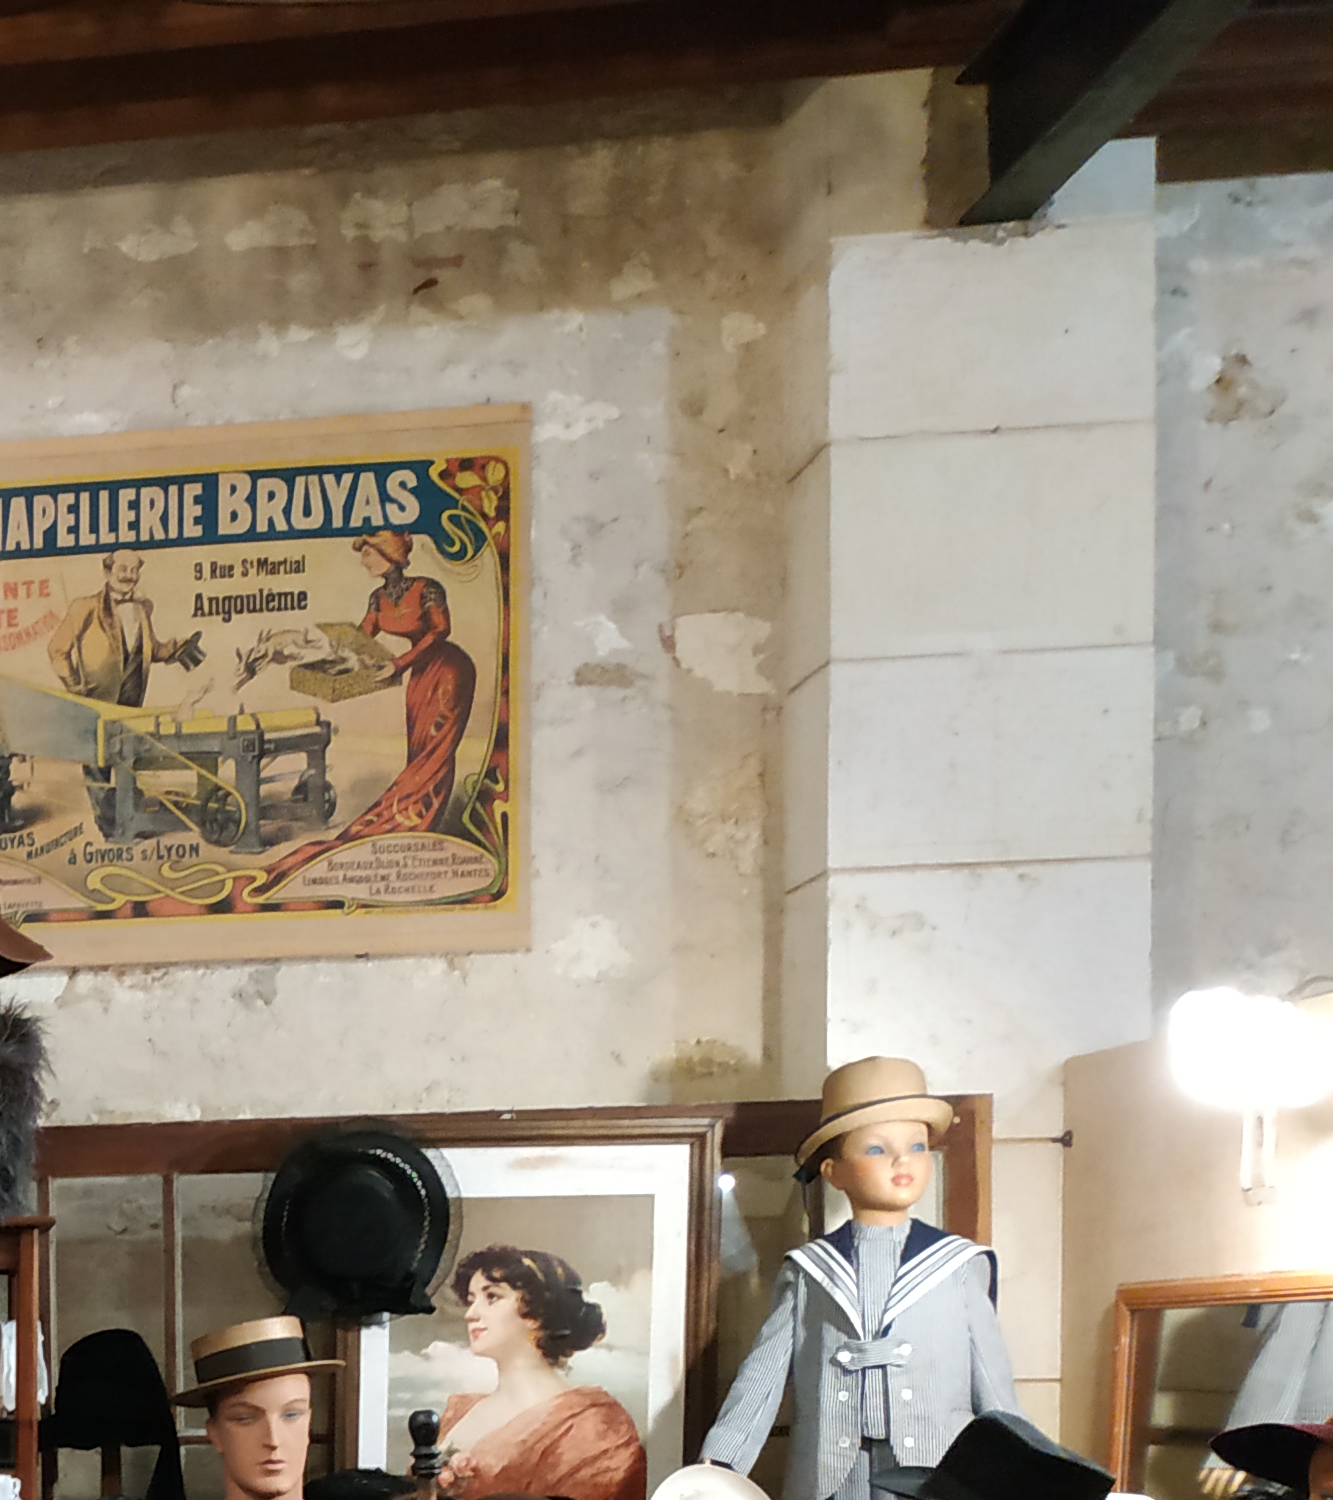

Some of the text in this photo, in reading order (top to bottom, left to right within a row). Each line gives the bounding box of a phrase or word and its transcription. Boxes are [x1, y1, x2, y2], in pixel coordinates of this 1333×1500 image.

[217, 469, 420, 535] BRUYAS
[209, 560, 235, 580] Rue
[256, 553, 306, 576] Martial
[192, 587, 308, 623] Angoulême
[83, 841, 134, 864] GIVORS
